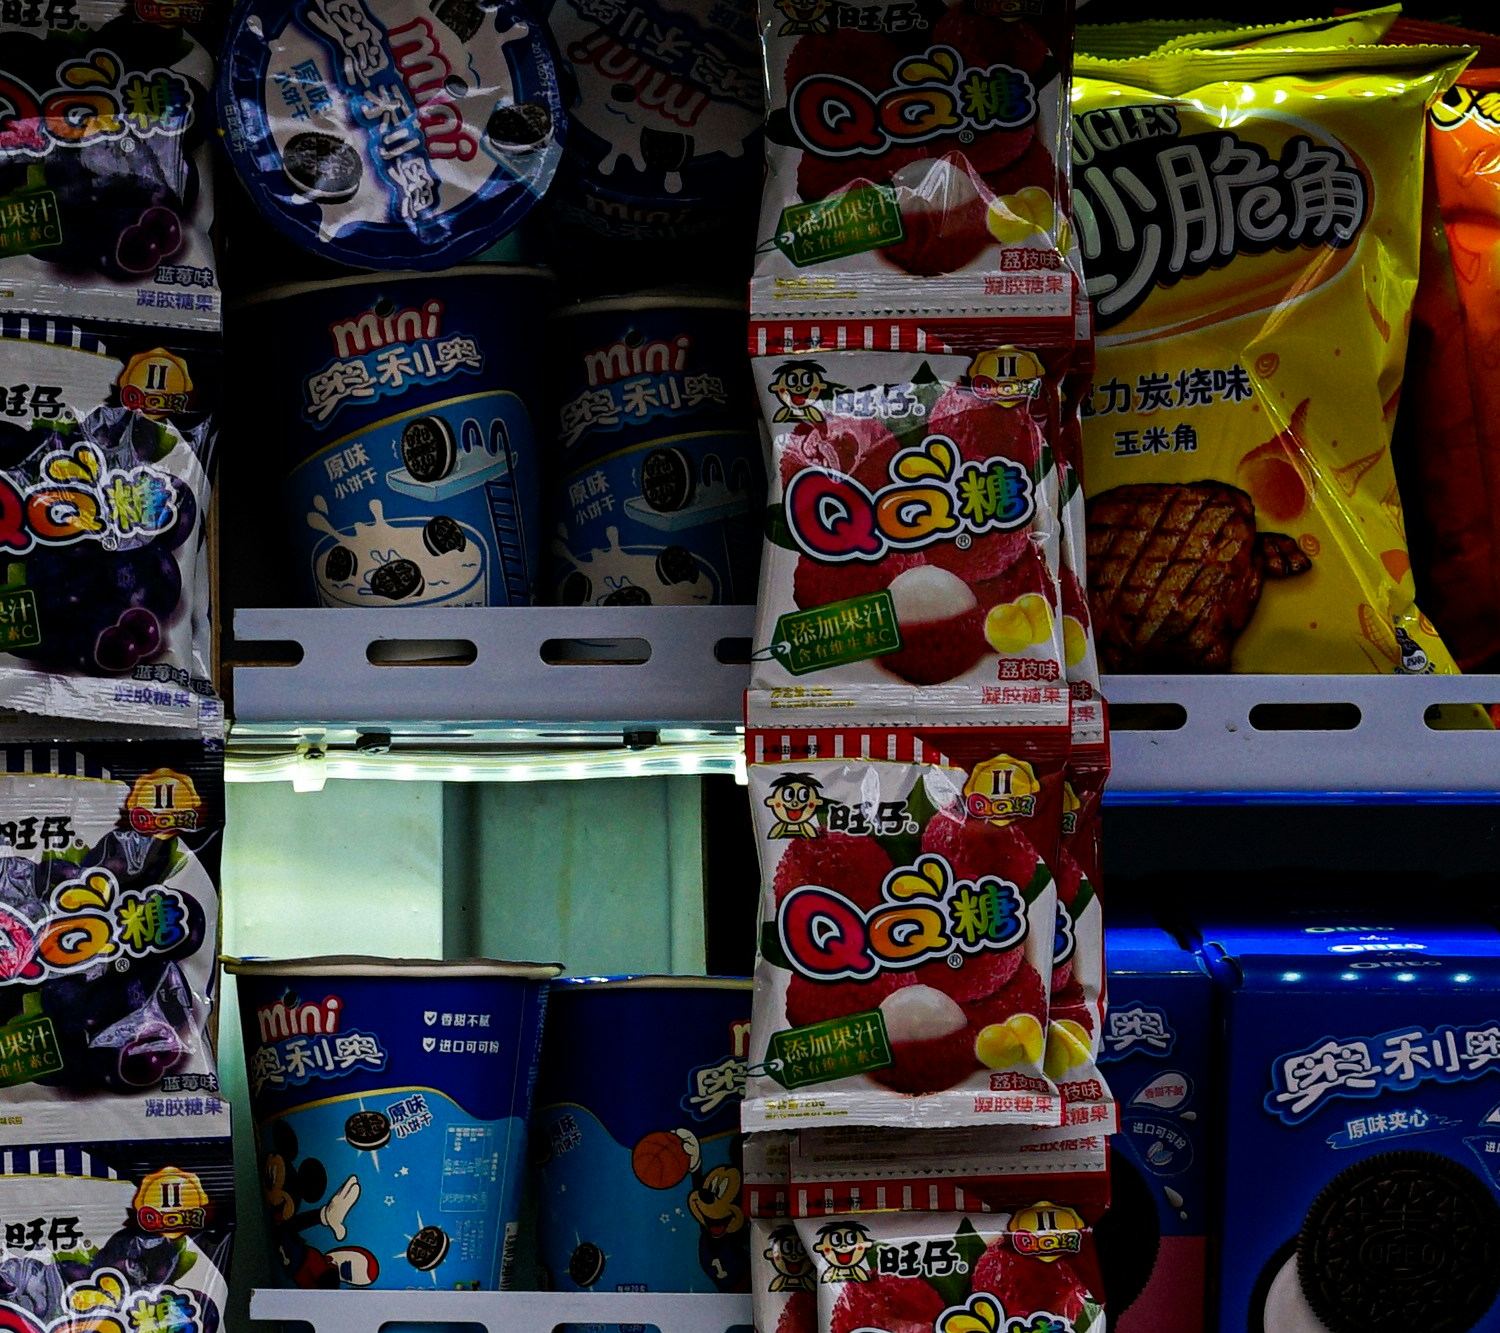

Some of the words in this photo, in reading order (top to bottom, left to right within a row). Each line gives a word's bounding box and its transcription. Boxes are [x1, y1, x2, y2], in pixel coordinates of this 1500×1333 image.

[332, 301, 443, 357] mini
[305, 334, 483, 423] 奥利奥
[323, 448, 367, 480] 原味
[332, 470, 377, 502] 小饼干
[786, 435, 1037, 565] QQ糖
[1000, 660, 1059, 681] 荔枝味
[981, 684, 1061, 705] 凝胶糖果
[441, 1012, 490, 1029] 香甜不腻
[439, 1039, 500, 1055] 进口可可粉
[1345, 1108, 1430, 1140] 原味夹心
